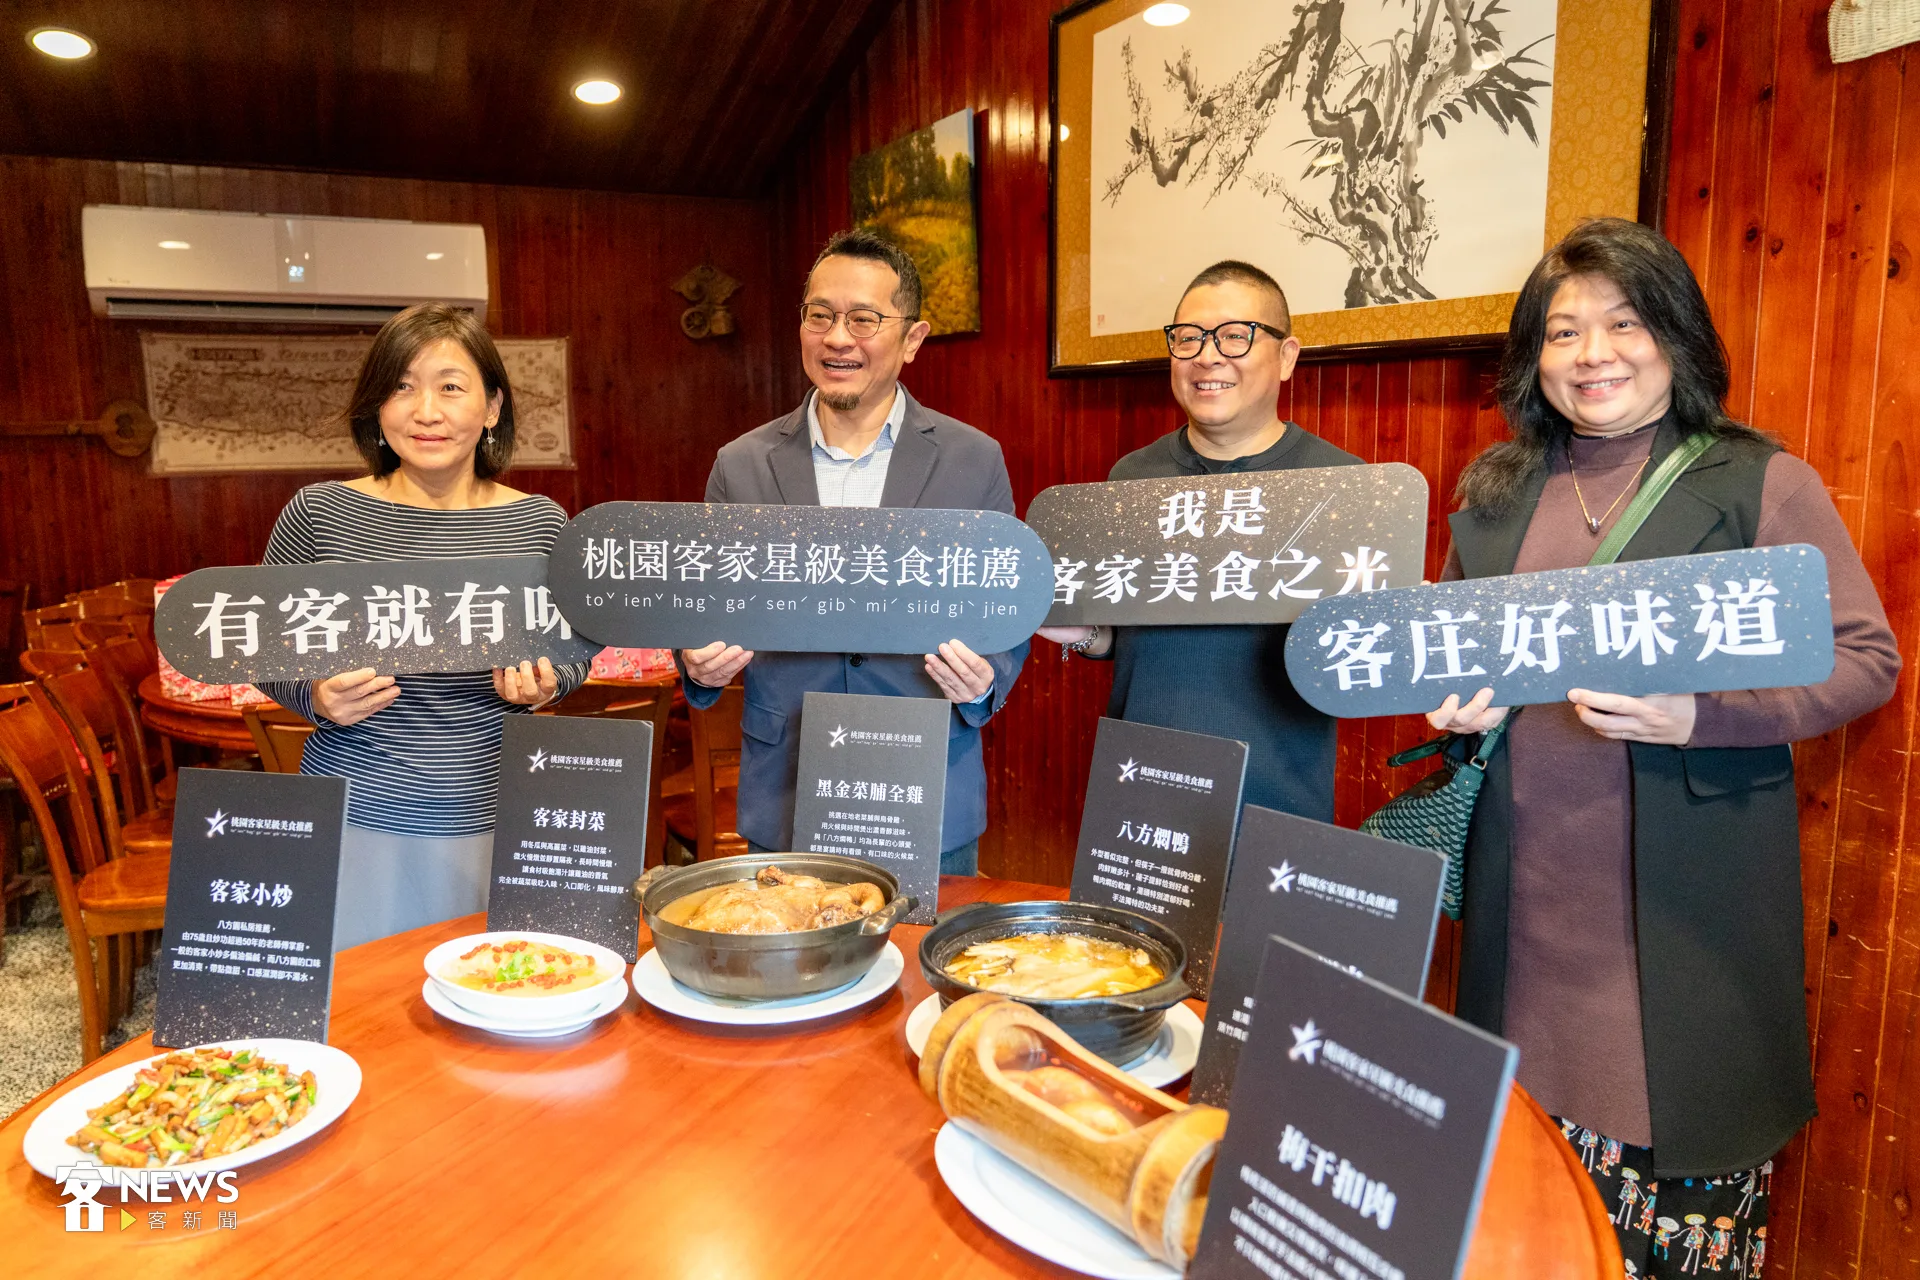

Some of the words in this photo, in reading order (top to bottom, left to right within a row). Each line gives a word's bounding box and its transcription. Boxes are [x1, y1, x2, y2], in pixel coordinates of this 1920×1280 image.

[1158, 487, 1267, 540] 我是
[583, 538, 1021, 590] 桃園客家星級美食推薦
[1053, 546, 1391, 605] 客家美食之光
[908, 599, 940, 615] siid
[983, 600, 1018, 618] jien
[1318, 578, 1785, 691] 客庄好味道
[815, 778, 925, 805] 黑金菜脯全雞
[533, 807, 606, 832] 客家封菜
[1117, 820, 1191, 855] 八方燜鴨
[209, 878, 293, 908] 客家小炒
